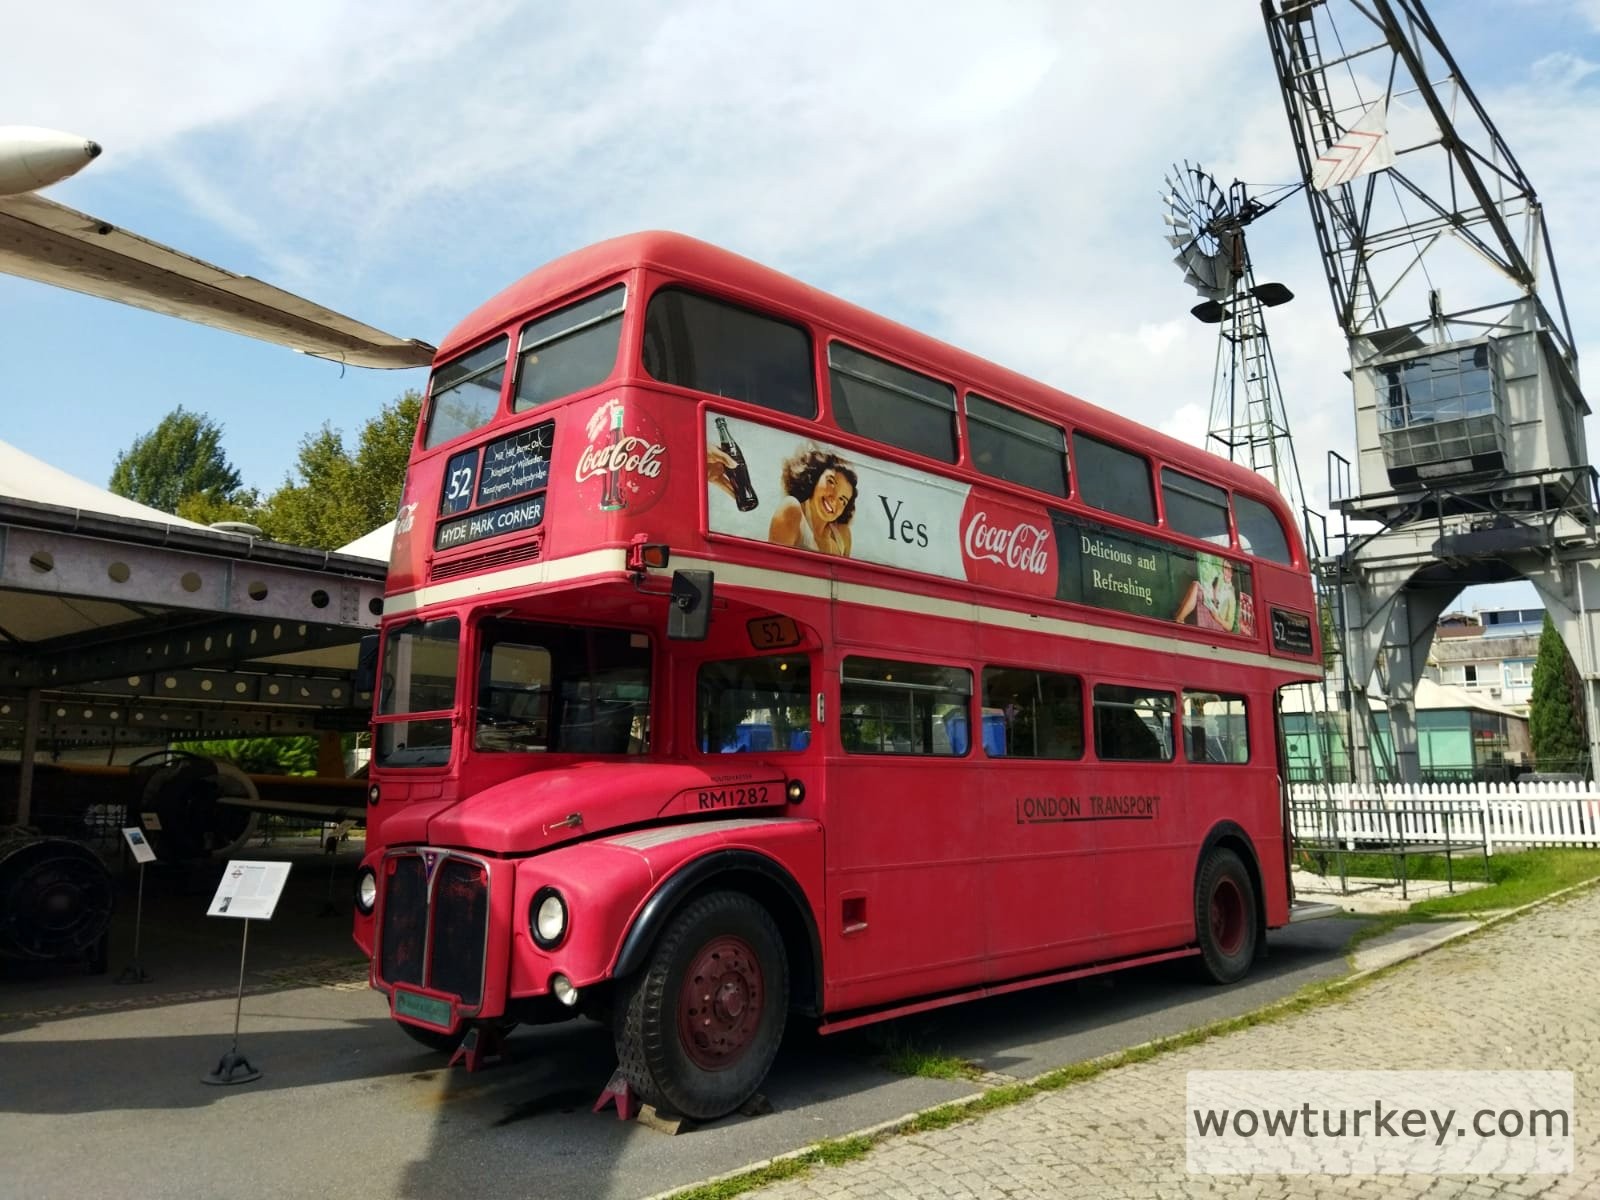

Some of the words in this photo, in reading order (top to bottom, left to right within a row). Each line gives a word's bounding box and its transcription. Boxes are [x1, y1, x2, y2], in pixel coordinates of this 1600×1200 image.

[448, 467, 472, 500] 52
[441, 524, 467, 543] HYDE
[470, 517, 495, 536] PARK
[497, 504, 541, 528] CORNER
[878, 494, 929, 548] Yes
[965, 511, 1049, 575] Coca-Cola
[1081, 535, 1133, 566] Delicious
[1137, 554, 1156, 571] and
[1092, 569, 1153, 606] Refreshing
[762, 623, 785, 643] 52
[1274, 621, 1286, 640] 52
[698, 786, 769, 809] RM1282
[1016, 797, 1081, 824] LONDON
[1089, 795, 1161, 820] TRANSPORT
